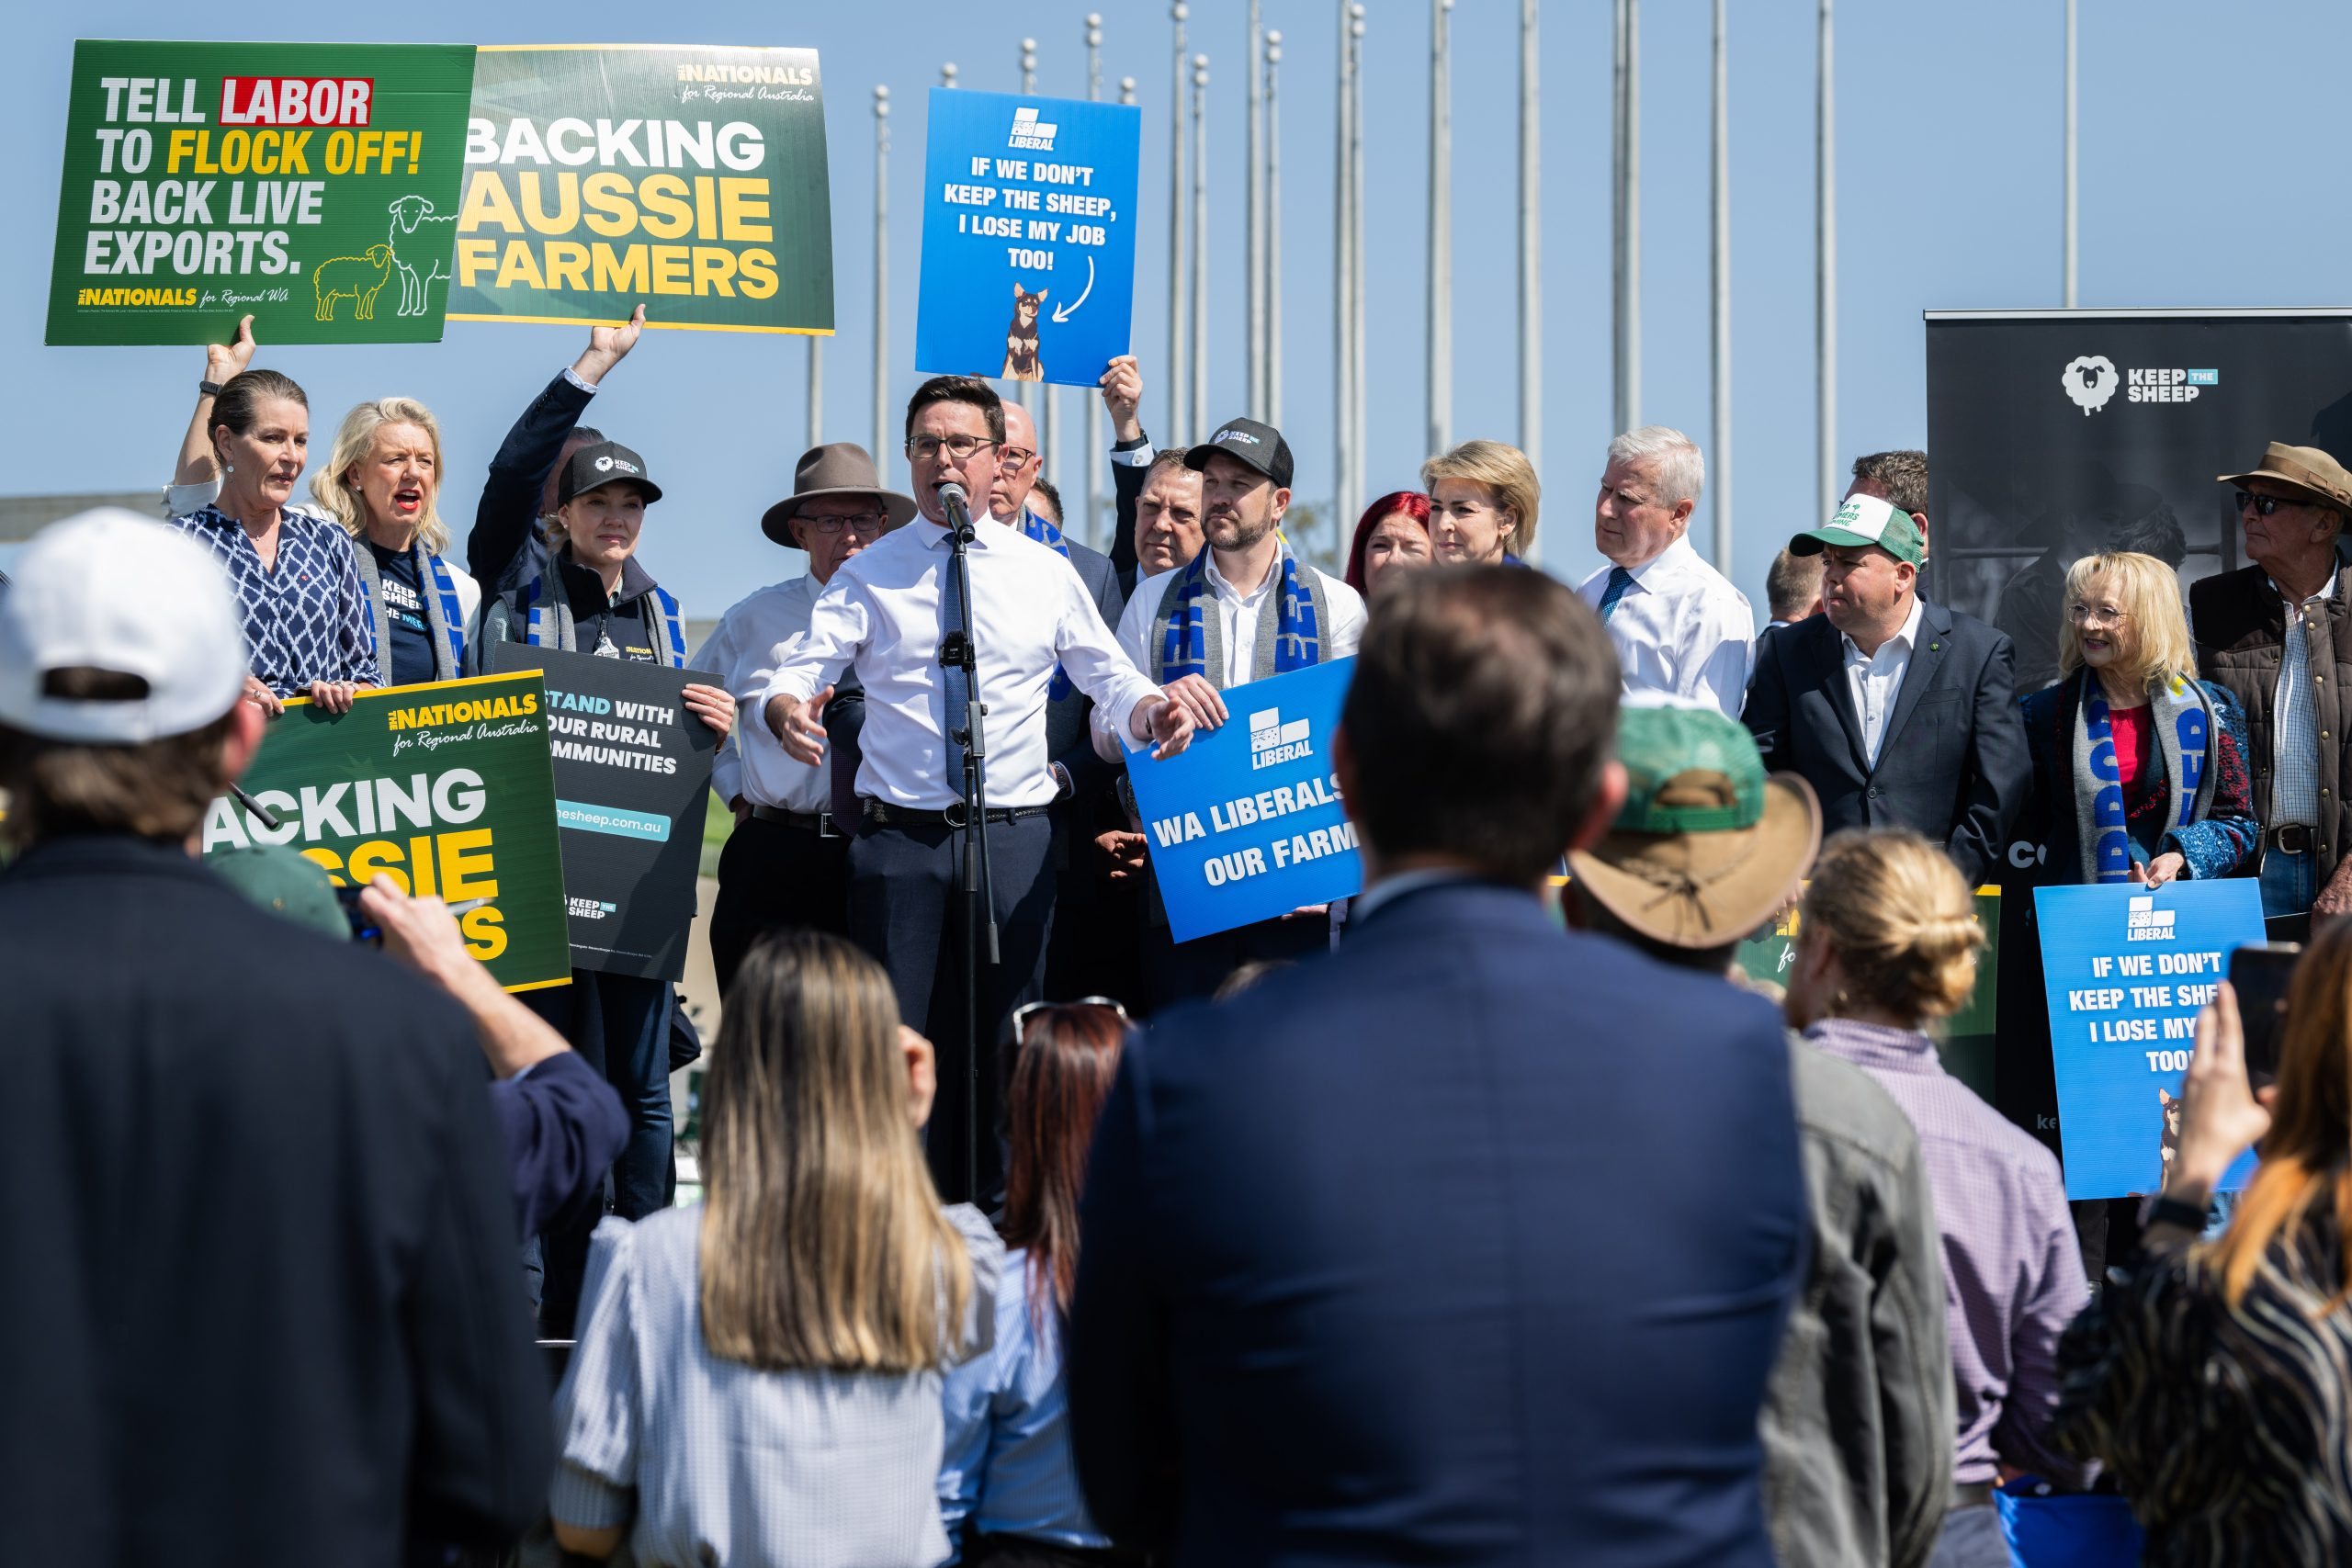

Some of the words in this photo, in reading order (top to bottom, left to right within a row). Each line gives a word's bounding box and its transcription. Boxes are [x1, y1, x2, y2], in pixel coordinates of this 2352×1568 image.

[685, 64, 813, 85] NATIONALS
[100, 77, 206, 122] TELL
[220, 78, 370, 124] LABOR
[682, 85, 700, 103] for
[704, 85, 755, 103] Regional
[758, 86, 815, 101] Australia
[96, 129, 153, 174] TO
[166, 129, 313, 175] FLOCK
[324, 130, 423, 175] OFF!
[464, 117, 765, 171] BACKING
[1008, 135, 1054, 152] LIBERAL
[971, 156, 991, 176] IF
[996, 159, 1027, 181] WE
[1033, 162, 1094, 186] DON'T
[90, 179, 217, 225] BACK
[229, 180, 325, 225] LIVE
[457, 171, 774, 243] AUSSIE
[944, 183, 997, 207] KEEP
[1002, 187, 1040, 211] THE
[1046, 192, 1117, 222] SHEEP,
[958, 214, 967, 233] I
[972, 215, 1023, 239] LOSE
[1028, 220, 1061, 243] MY
[1066, 223, 1106, 246] JOB
[84, 230, 301, 276] EXPORTS.
[1007, 247, 1054, 271] TOO!
[457, 238, 779, 299] FARMERS
[85, 288, 198, 306] NATIONALS
[199, 289, 217, 309] for
[220, 287, 264, 307] Regional
[267, 287, 289, 302] WA
[2128, 368, 2187, 386] KEEP
[2190, 372, 2214, 381] THE
[2128, 385, 2199, 402] SHEEP
[382, 579, 417, 599] KEEP
[386, 607, 400, 620] HE
[388, 710, 398, 731] THE
[397, 694, 537, 730] NATIONALS
[615, 700, 674, 726] WITH
[393, 734, 413, 758] for
[417, 725, 473, 751] Regional
[476, 718, 539, 739] Australia
[591, 721, 662, 748] RURAL
[550, 740, 677, 774] MMUNITIES
[1252, 739, 1314, 771] LIBERAL
[202, 768, 486, 853] ACKING
[1152, 811, 1207, 848] WA
[1209, 772, 1346, 833] LIBERALS
[1204, 847, 1268, 886] OUR
[569, 907, 605, 919] SHEEP
[570, 897, 600, 909] KEEP
[2127, 926, 2176, 942] LIBERAL
[2092, 956, 2113, 978] IF
[2118, 954, 2154, 976] WE
[2158, 952, 2222, 976] DON'T
[2069, 988, 2125, 1011] KEEP
[2130, 986, 2172, 1009] THE
[2177, 984, 2222, 1007] SHE
[2089, 1021, 2098, 1043] I
[2103, 1019, 2158, 1043] LOSE
[2163, 1017, 2197, 1039] MY
